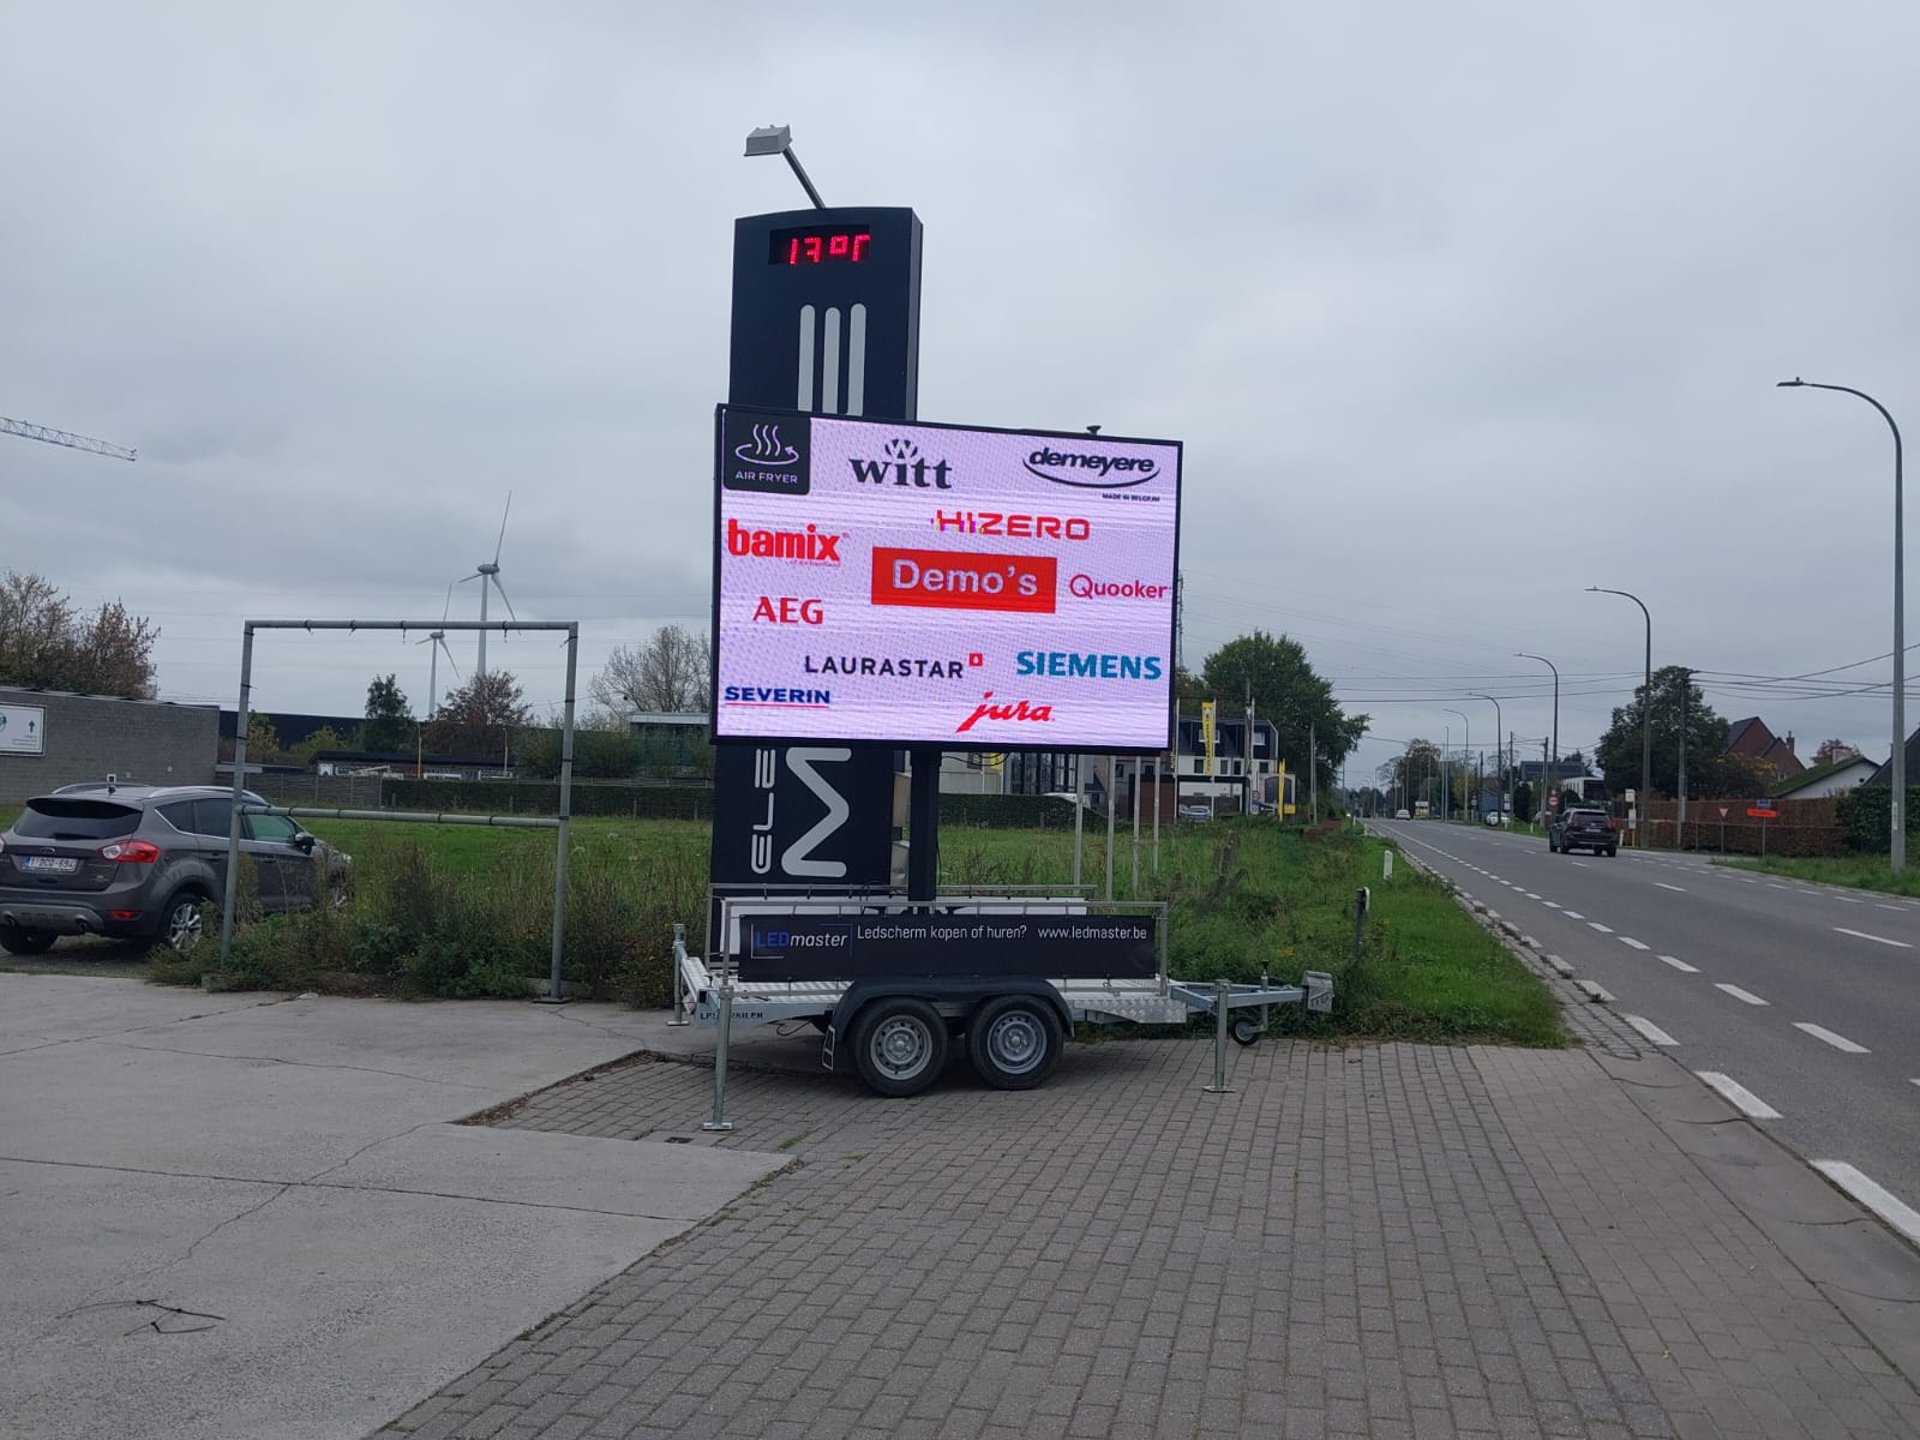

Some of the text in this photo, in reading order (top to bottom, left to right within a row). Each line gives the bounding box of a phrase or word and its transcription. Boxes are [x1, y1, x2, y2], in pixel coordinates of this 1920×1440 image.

[849, 456, 952, 489] witt
[1029, 447, 1155, 477] demeyere
[734, 471, 799, 484] AIR FRYER
[728, 518, 841, 561] bamix
[936, 509, 1090, 541] HIZERO
[892, 559, 1038, 595] Demo's
[1069, 574, 1168, 600] Quooker
[753, 595, 824, 625] AEG
[804, 655, 963, 678] LAURASTAR
[1016, 650, 1162, 680] SIEMENS
[724, 686, 830, 704] SEVERIN
[956, 691, 1052, 732] jura
[857, 925, 1147, 941] Ledscherm kopen of huren? www.ledmaster.be
